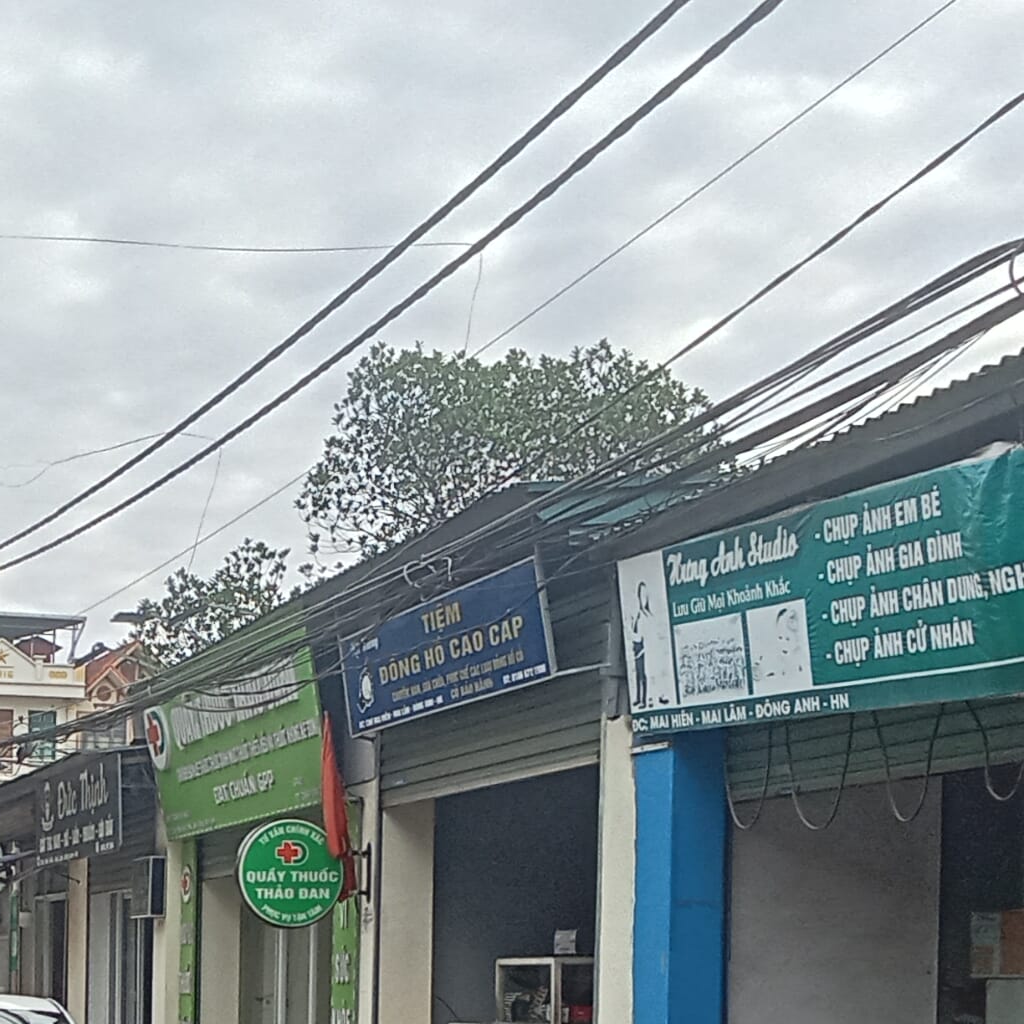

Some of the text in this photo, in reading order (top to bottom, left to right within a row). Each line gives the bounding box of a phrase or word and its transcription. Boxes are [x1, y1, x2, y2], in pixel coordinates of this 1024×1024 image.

[823, 485, 943, 545] CHỤP ẢNH EM BÉ
[747, 525, 799, 566] Studio
[827, 530, 964, 585] CHỤP ẢNH GIA ĐÌNH
[830, 596, 866, 627] CHỤP
[870, 586, 900, 618] ẢNH
[902, 577, 945, 612] CHÂN
[449, 630, 484, 659] CAO
[834, 616, 975, 667] CHỤP ẢNH CỬ NHÂN
[649, 715, 670, 730] MAI
[701, 710, 723, 725] MAI
[723, 703, 747, 722] LÂM
[755, 699, 791, 718] ĐÔNG
[794, 696, 821, 713] ANH
[830, 693, 850, 710] HN
[255, 883, 295, 900] THẢO
[289, 867, 339, 883] THUỐC
